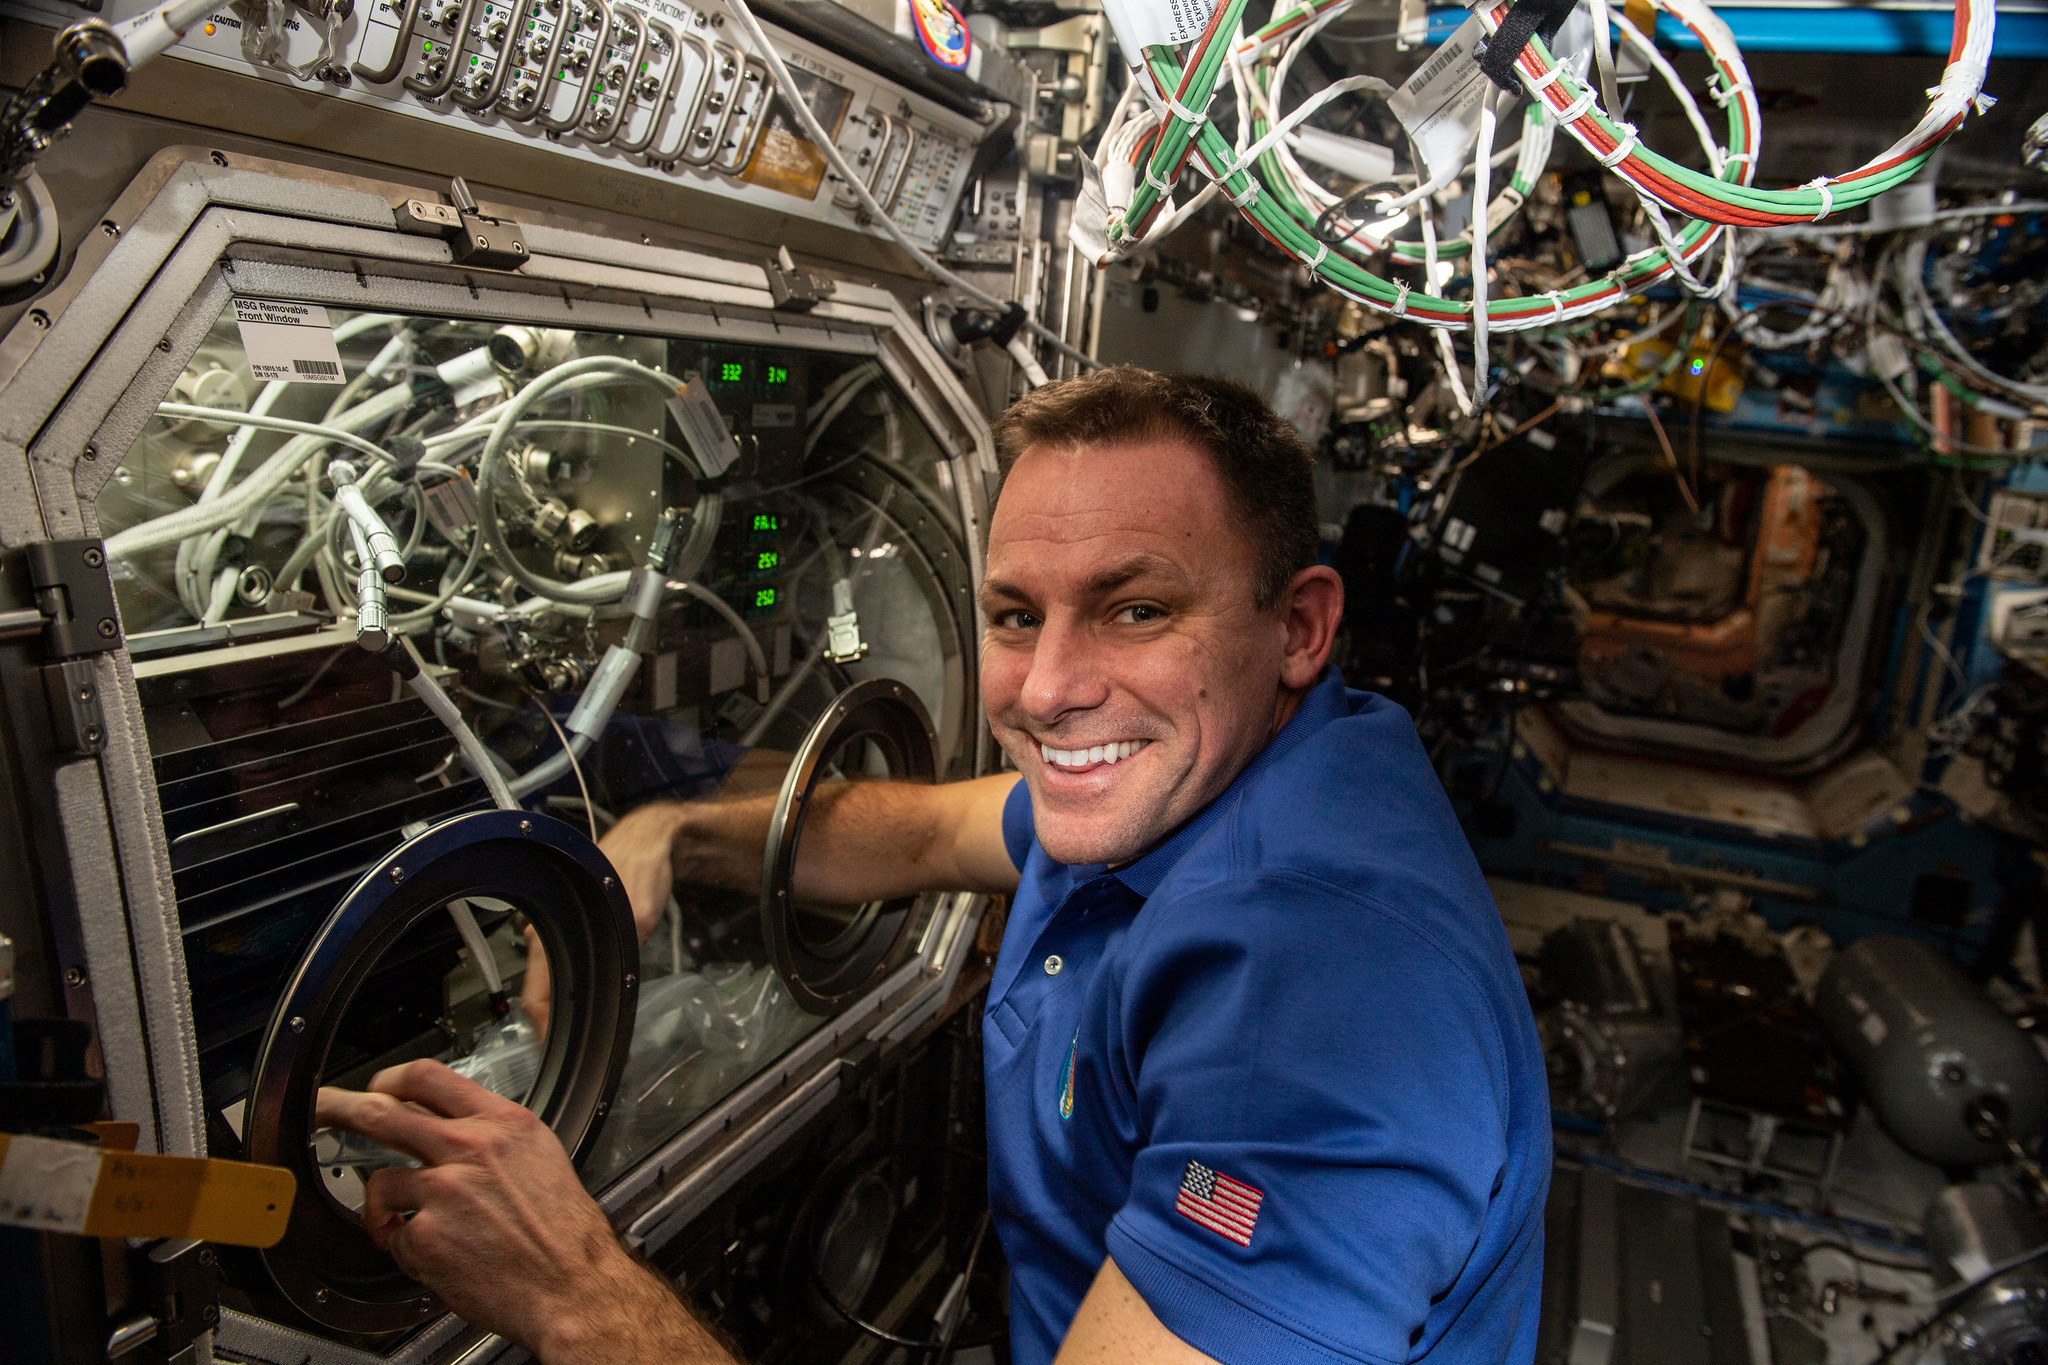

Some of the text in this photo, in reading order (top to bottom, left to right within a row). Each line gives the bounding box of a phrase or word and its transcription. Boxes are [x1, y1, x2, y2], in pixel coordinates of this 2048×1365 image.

[380, 4, 390, 12] OFF
[654, 0, 686, 21] FUNCTIONS
[1182, 0, 1196, 29] Jumper
[214, 16, 241, 30] CAUTION
[283, 18, 300, 32] J706
[430, 20, 440, 28] OFF
[1200, 22, 1207, 32] To
[539, 23, 551, 34] MODE
[1170, 32, 1178, 42] P1
[435, 47, 450, 57] +28V
[481, 61, 494, 71] +28V
[416, 73, 426, 81] OFF
[234, 300, 308, 314] MSG Removable
[237, 311, 300, 324] Front Window
